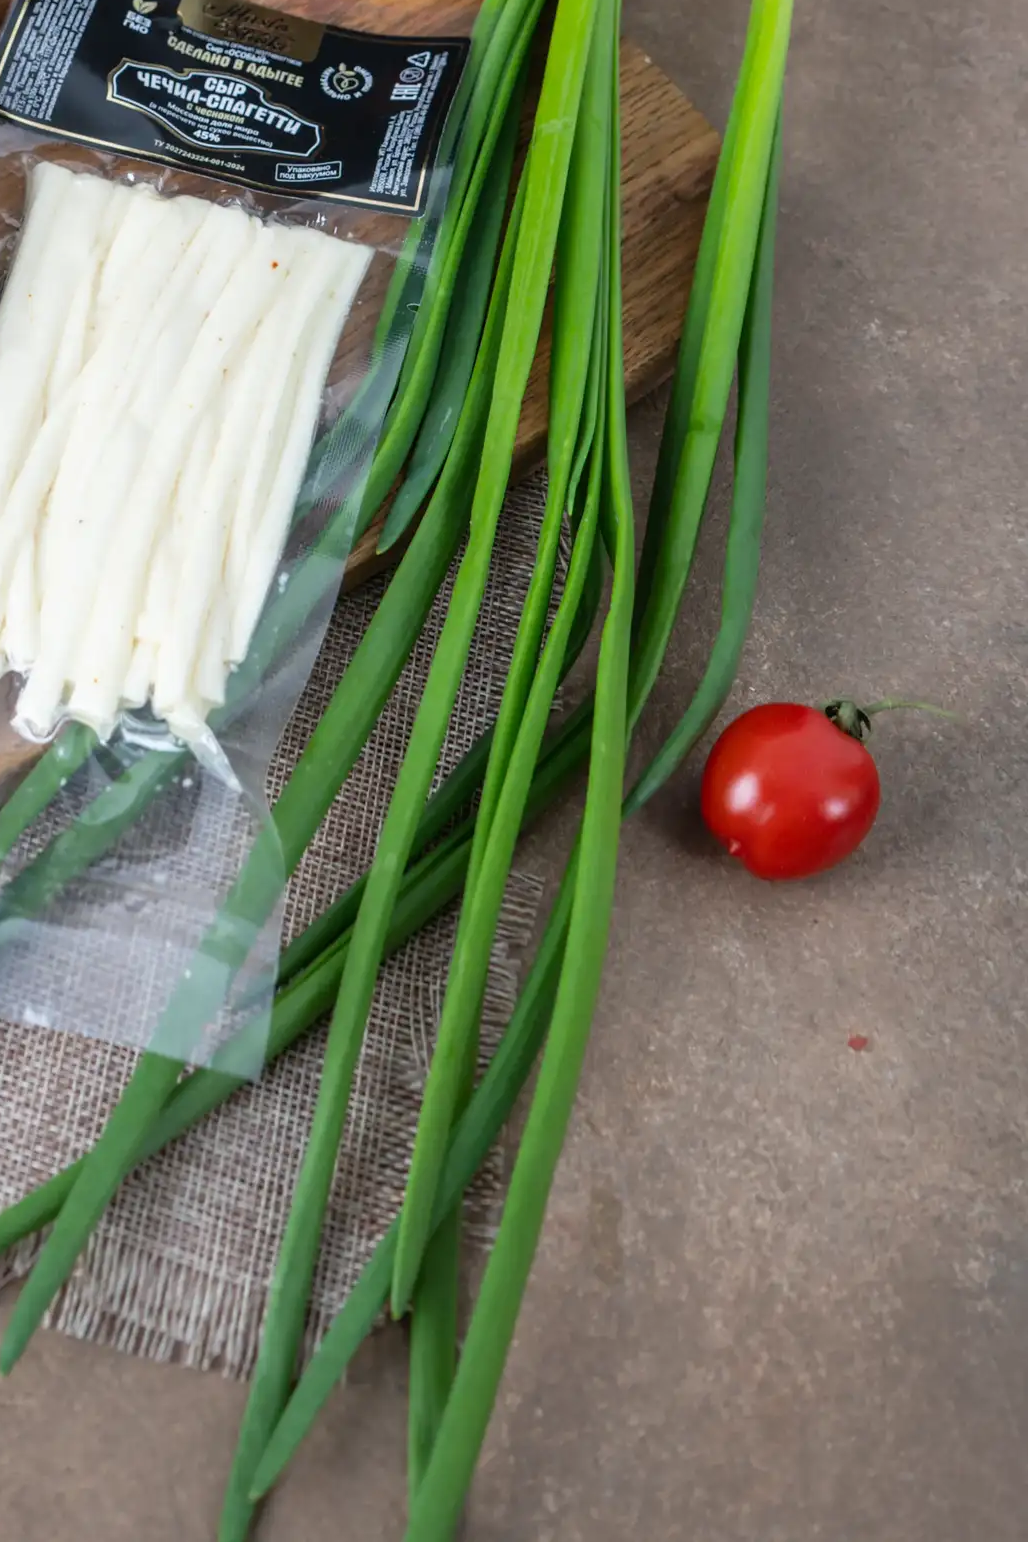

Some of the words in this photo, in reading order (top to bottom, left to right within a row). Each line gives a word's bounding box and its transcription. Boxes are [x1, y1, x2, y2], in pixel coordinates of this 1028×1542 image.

[123, 18, 149, 35] ГМО
[126, 10, 152, 28] БЕЗ
[167, 35, 230, 68] СДЕЛАНО
[233, 59, 245, 70] В
[246, 62, 304, 88] АДЫГЕЕ
[204, 77, 247, 97] СЫР
[137, 71, 301, 135] ЧЕЧИЛ-СПАГЕТТИ
[167, 102, 210, 124] Массовая
[210, 120, 233, 130] доля
[234, 124, 260, 137] жира
[195, 106, 245, 125] чесноком
[197, 123, 209, 131] на
[154, 139, 165, 148] ТУ
[193, 129, 221, 143] 45%
[280, 172, 296, 180] под
[297, 170, 337, 180] вакуумом
[287, 165, 331, 173] Упаковано
